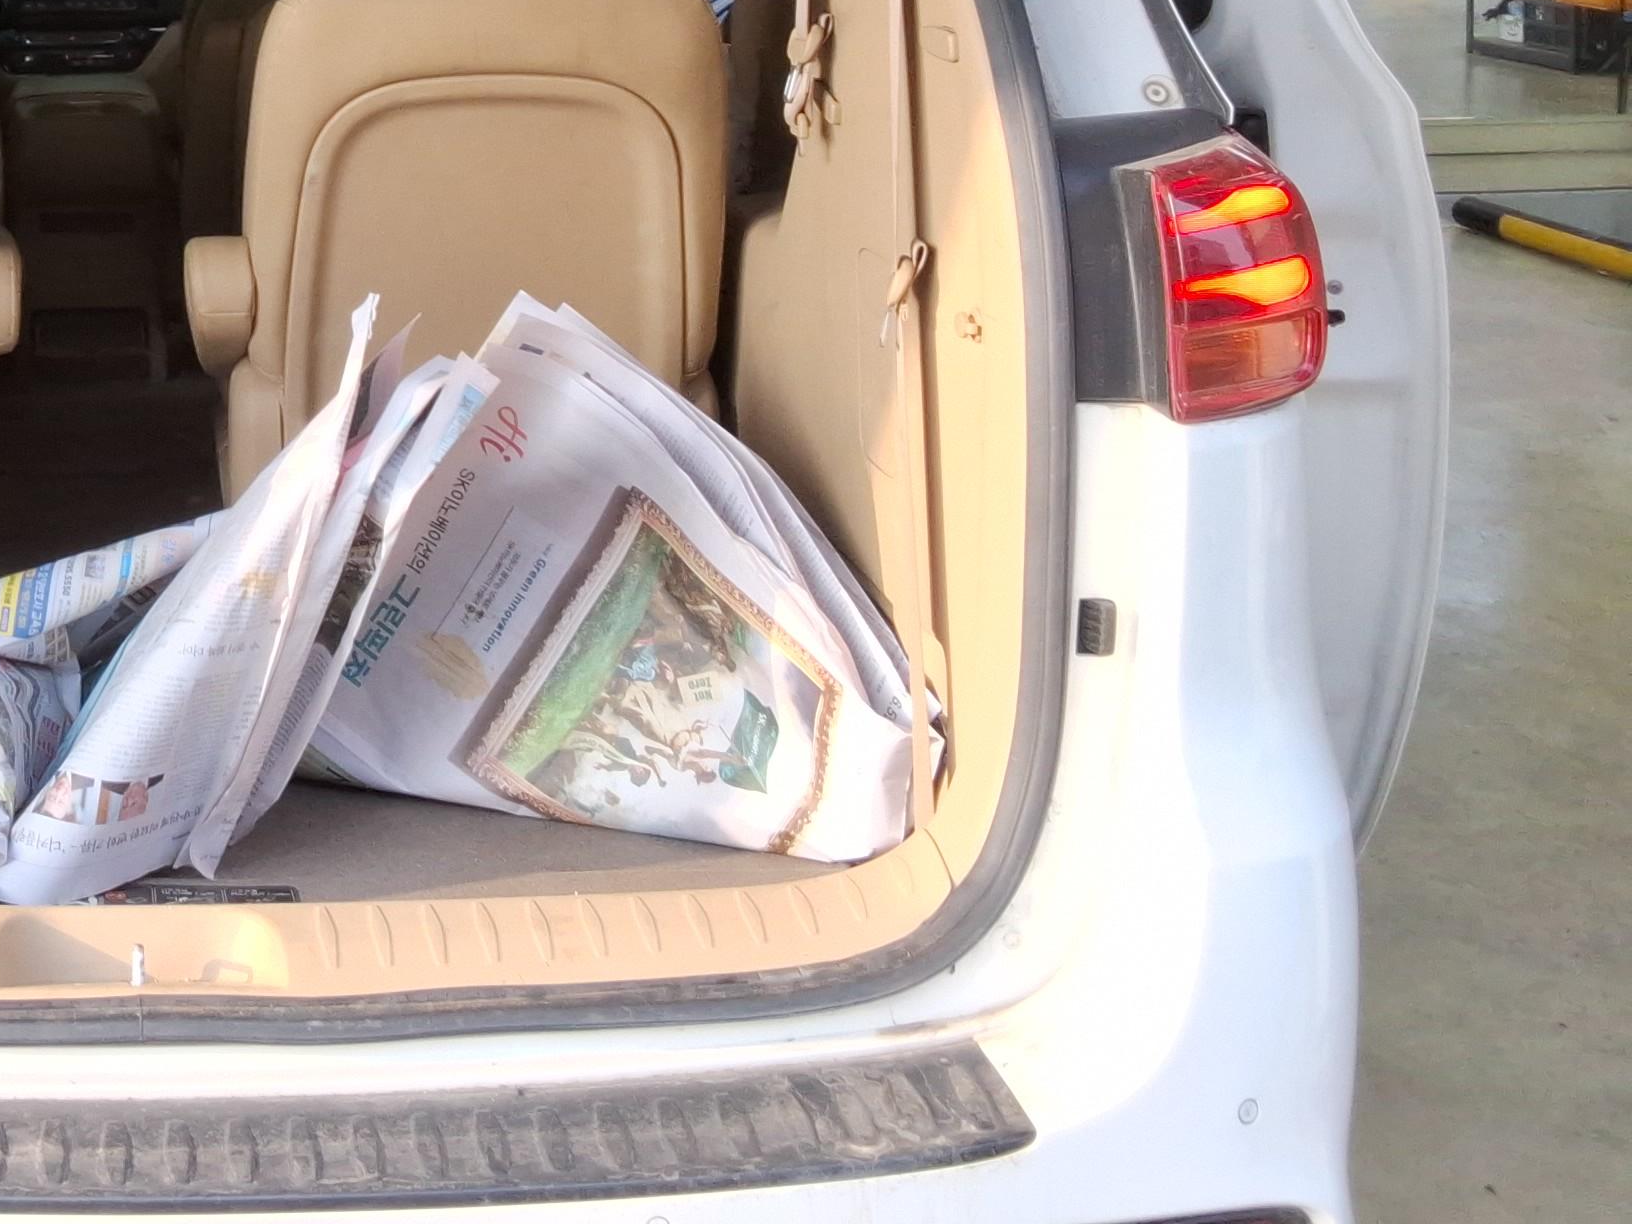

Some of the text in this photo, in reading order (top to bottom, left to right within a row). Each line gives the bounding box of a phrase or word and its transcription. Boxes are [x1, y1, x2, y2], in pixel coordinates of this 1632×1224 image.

[406, 468, 475, 574] SK이노베이션의
[519, 559, 548, 594] Green
[482, 591, 523, 652] Innovation
